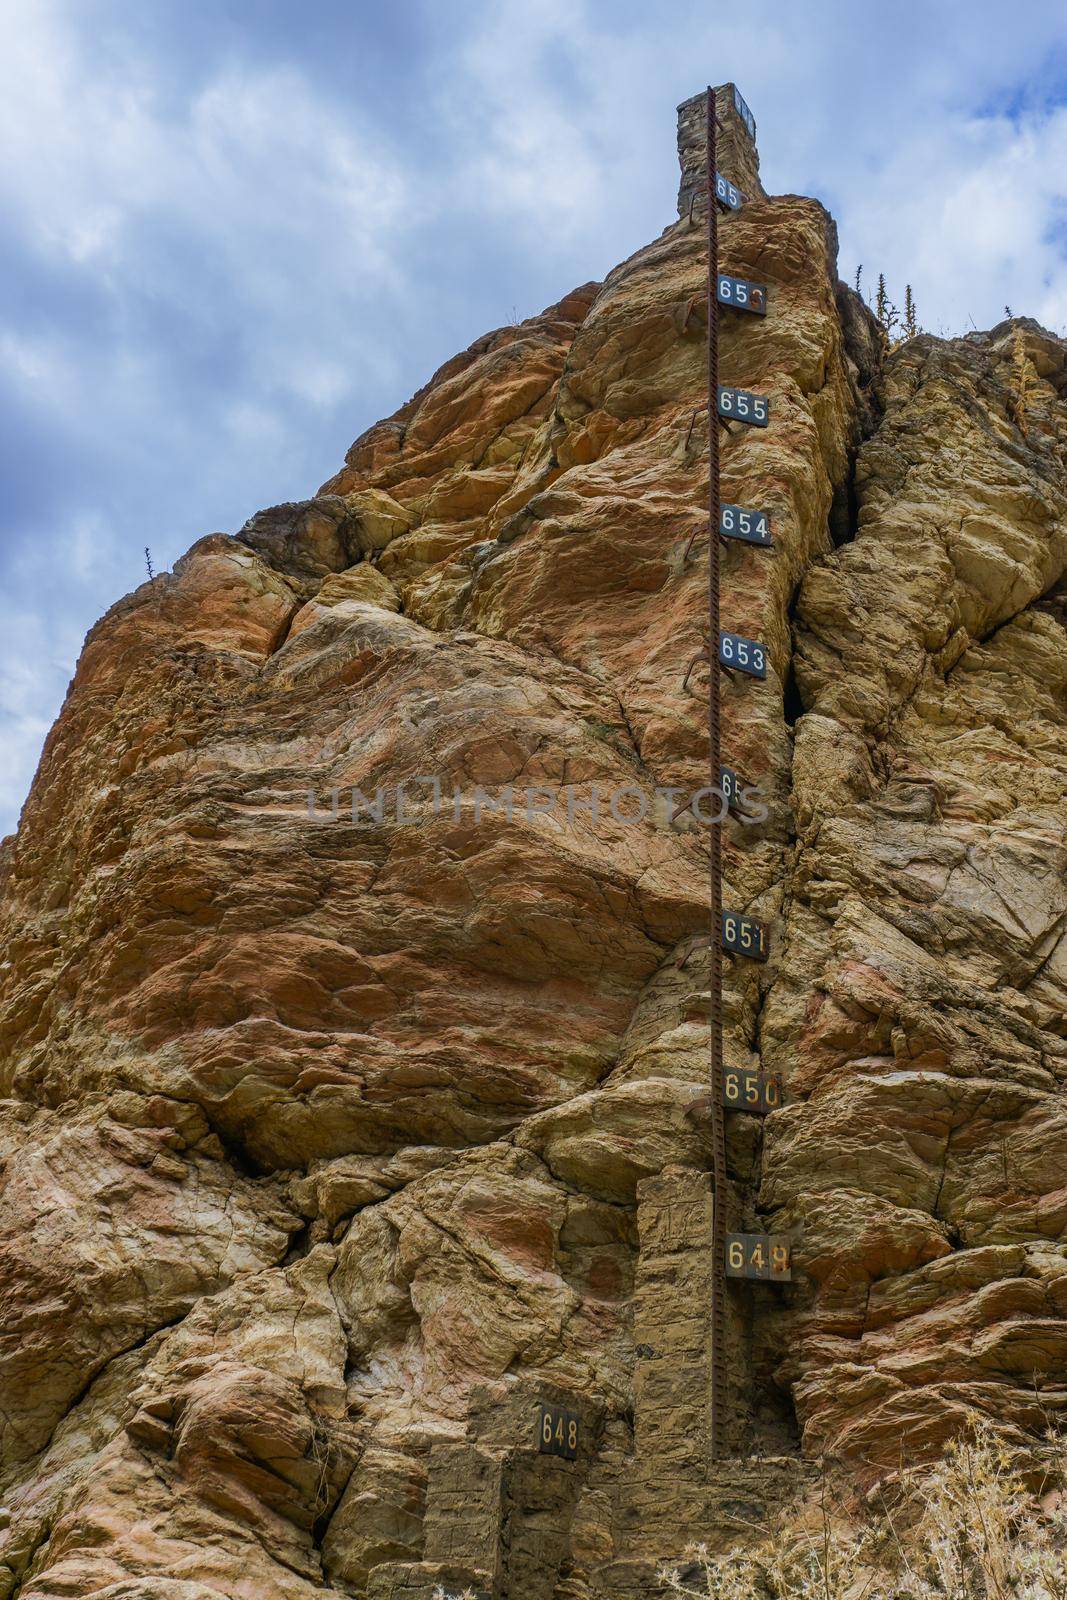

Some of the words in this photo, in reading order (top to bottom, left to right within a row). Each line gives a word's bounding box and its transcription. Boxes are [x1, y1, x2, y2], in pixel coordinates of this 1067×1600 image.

[721, 392, 765, 420] 655
[722, 510, 768, 538] 654
[722, 637, 764, 670] 653
[725, 918, 764, 952] 651
[726, 1074, 778, 1106] 650
[543, 1413, 577, 1450] 648
